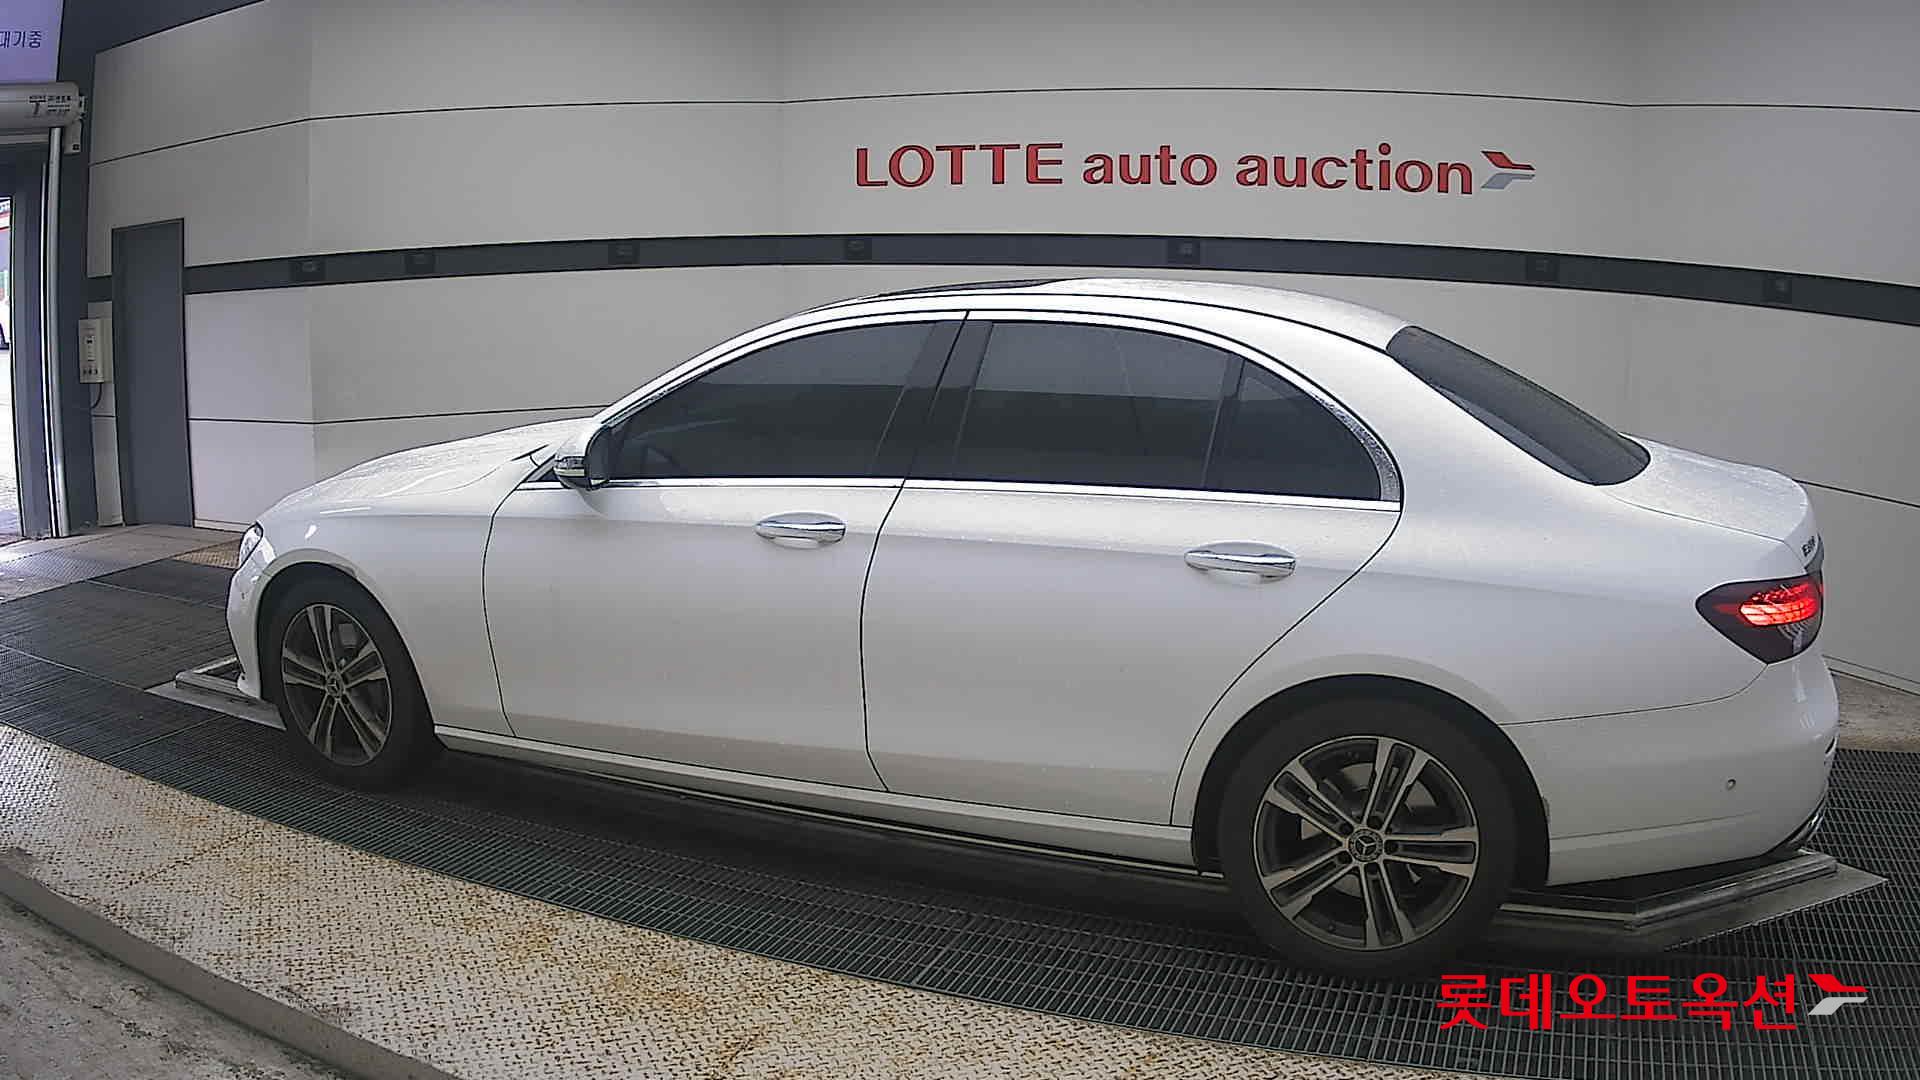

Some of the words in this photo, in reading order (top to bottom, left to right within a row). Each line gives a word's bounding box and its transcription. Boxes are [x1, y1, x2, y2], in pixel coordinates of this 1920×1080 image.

[856, 143, 1064, 188] LOTTE
[1082, 145, 1219, 186] auto
[1235, 143, 1475, 195] auction
